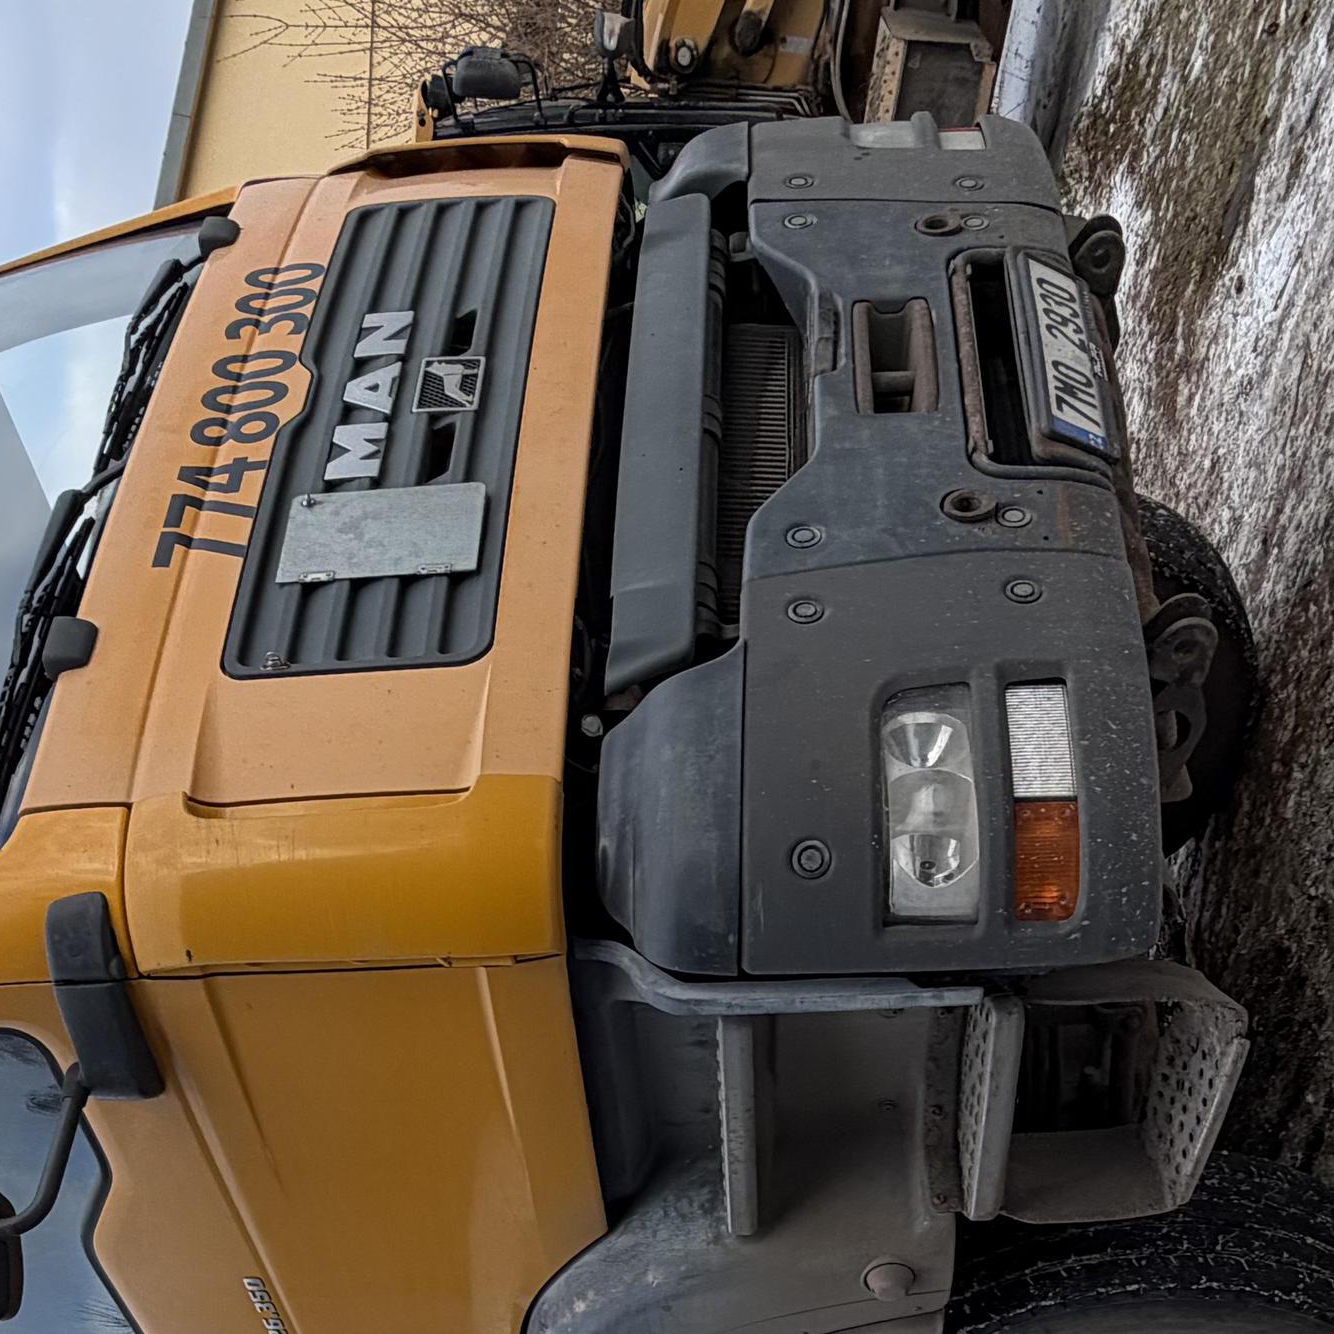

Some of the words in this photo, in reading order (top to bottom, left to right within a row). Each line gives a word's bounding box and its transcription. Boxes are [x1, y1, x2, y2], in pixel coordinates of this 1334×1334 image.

[225, 262, 325, 340] 300
[190, 350, 298, 446] 800
[324, 311, 415, 480] MAN
[152, 457, 267, 567] 774
